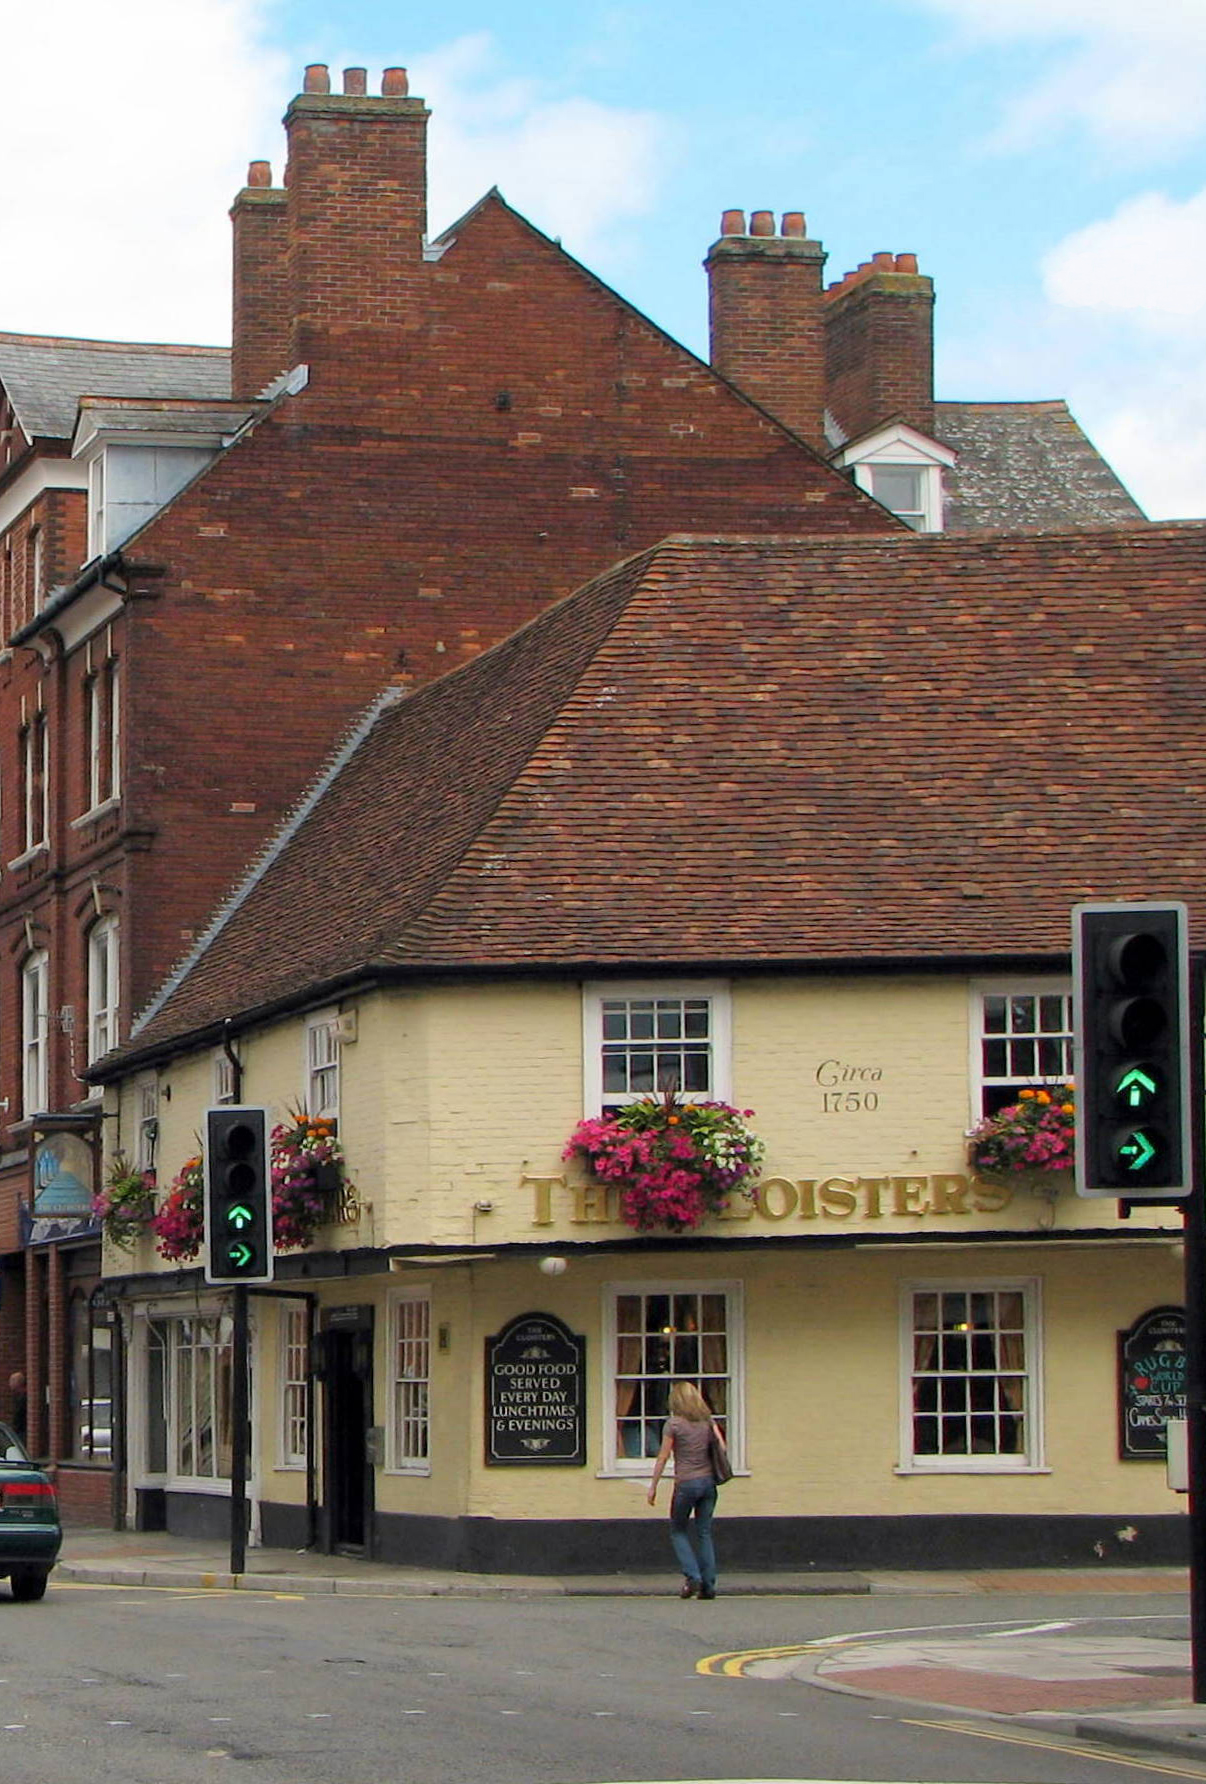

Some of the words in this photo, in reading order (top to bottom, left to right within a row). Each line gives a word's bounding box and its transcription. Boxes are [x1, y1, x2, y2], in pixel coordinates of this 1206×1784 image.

[816, 1059, 883, 1087] Circa
[823, 1092, 878, 1113] 1750
[518, 1173, 624, 1225] TH
[716, 1174, 1013, 1221] LOISTERS
[494, 1364, 536, 1376] GOOD
[538, 1363, 576, 1375] FOOD
[1134, 1354, 1187, 1377] RUGB
[510, 1378, 560, 1390] SERVED
[1150, 1382, 1181, 1394] CUP
[500, 1392, 539, 1404] EVERY
[542, 1391, 568, 1403] DAY
[493, 1405, 576, 1418] LUNCHTIMES
[496, 1420, 506, 1431] &
[509, 1418, 574, 1432] EVENINGS
